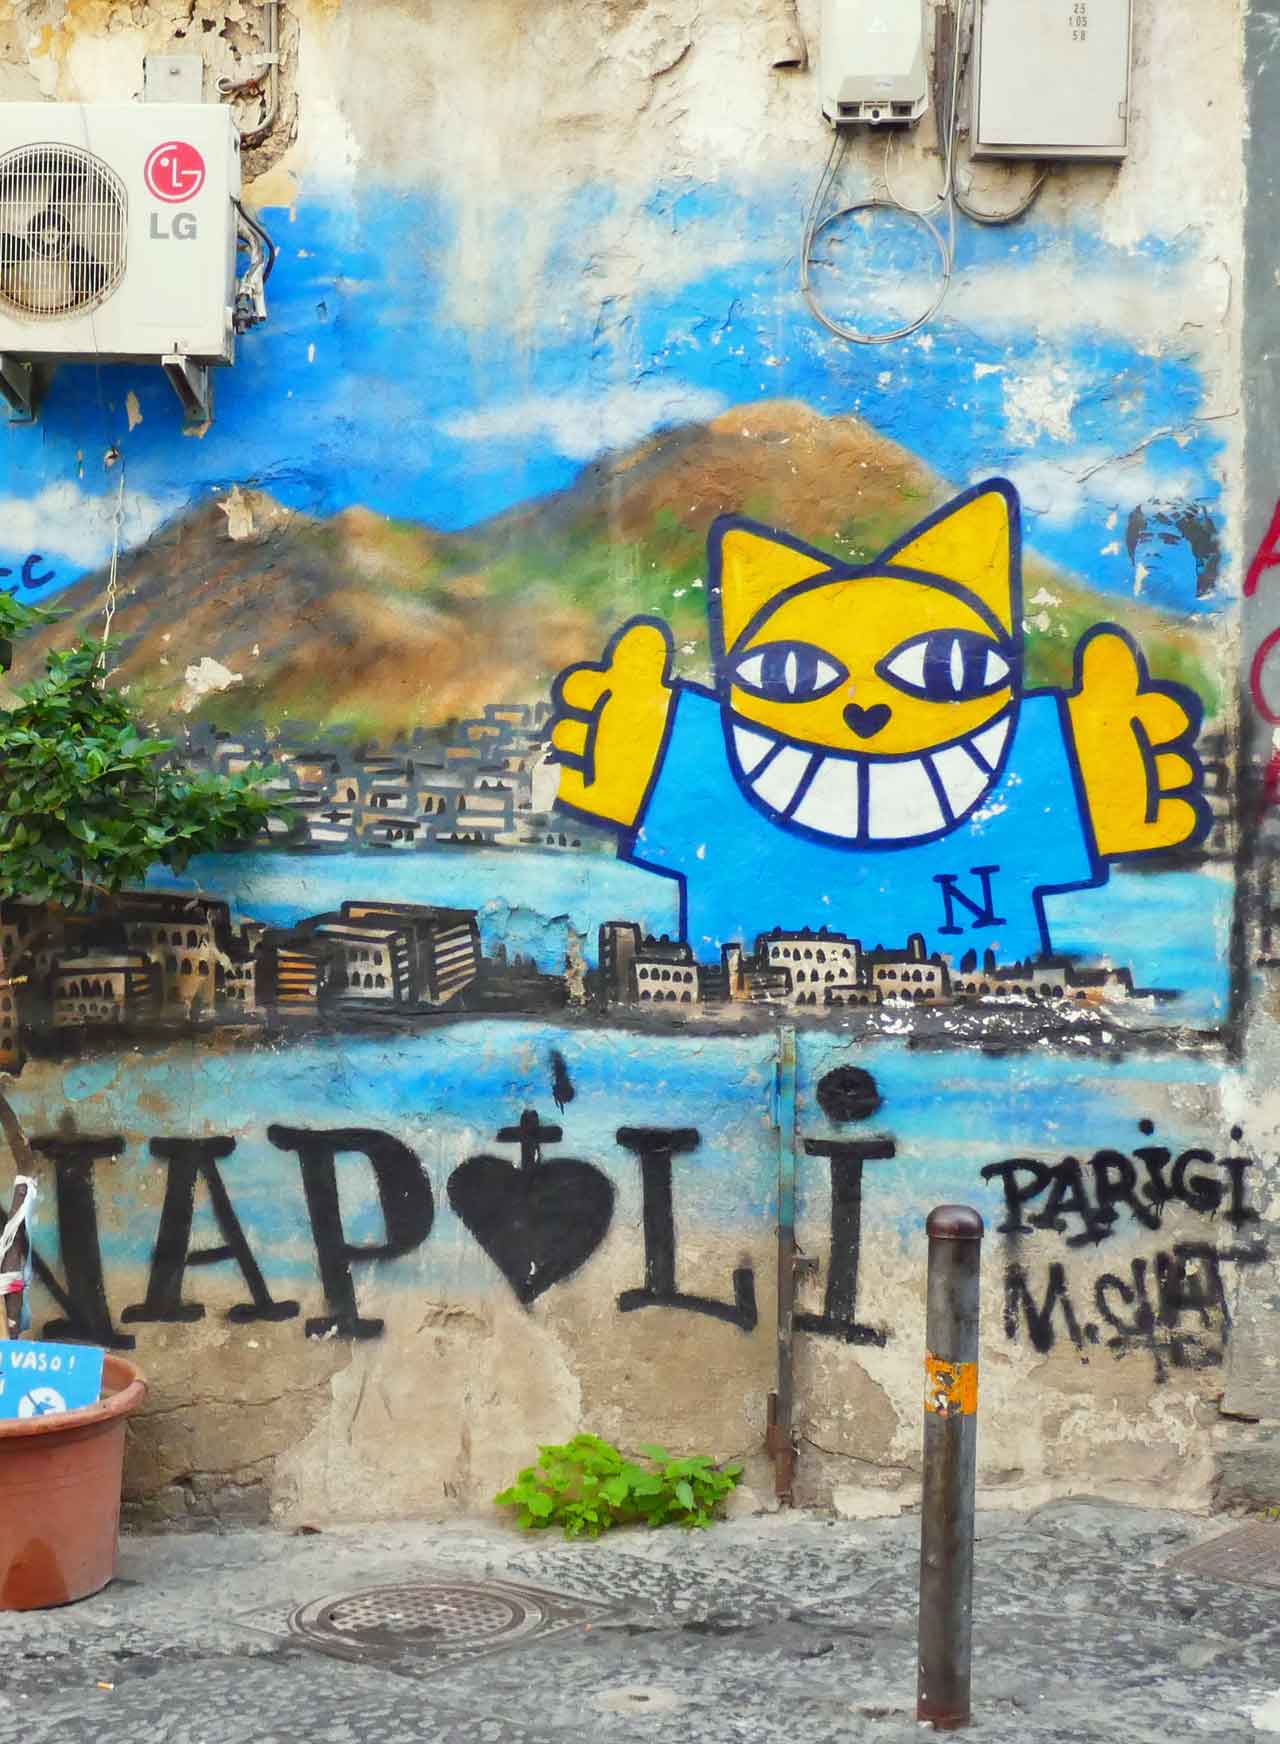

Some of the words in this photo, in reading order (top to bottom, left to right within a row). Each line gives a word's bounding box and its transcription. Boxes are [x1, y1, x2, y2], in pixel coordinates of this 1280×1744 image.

[149, 212, 198, 240] LG
[932, 864, 1007, 935] N
[980, 1117, 1261, 1248] PARIGI
